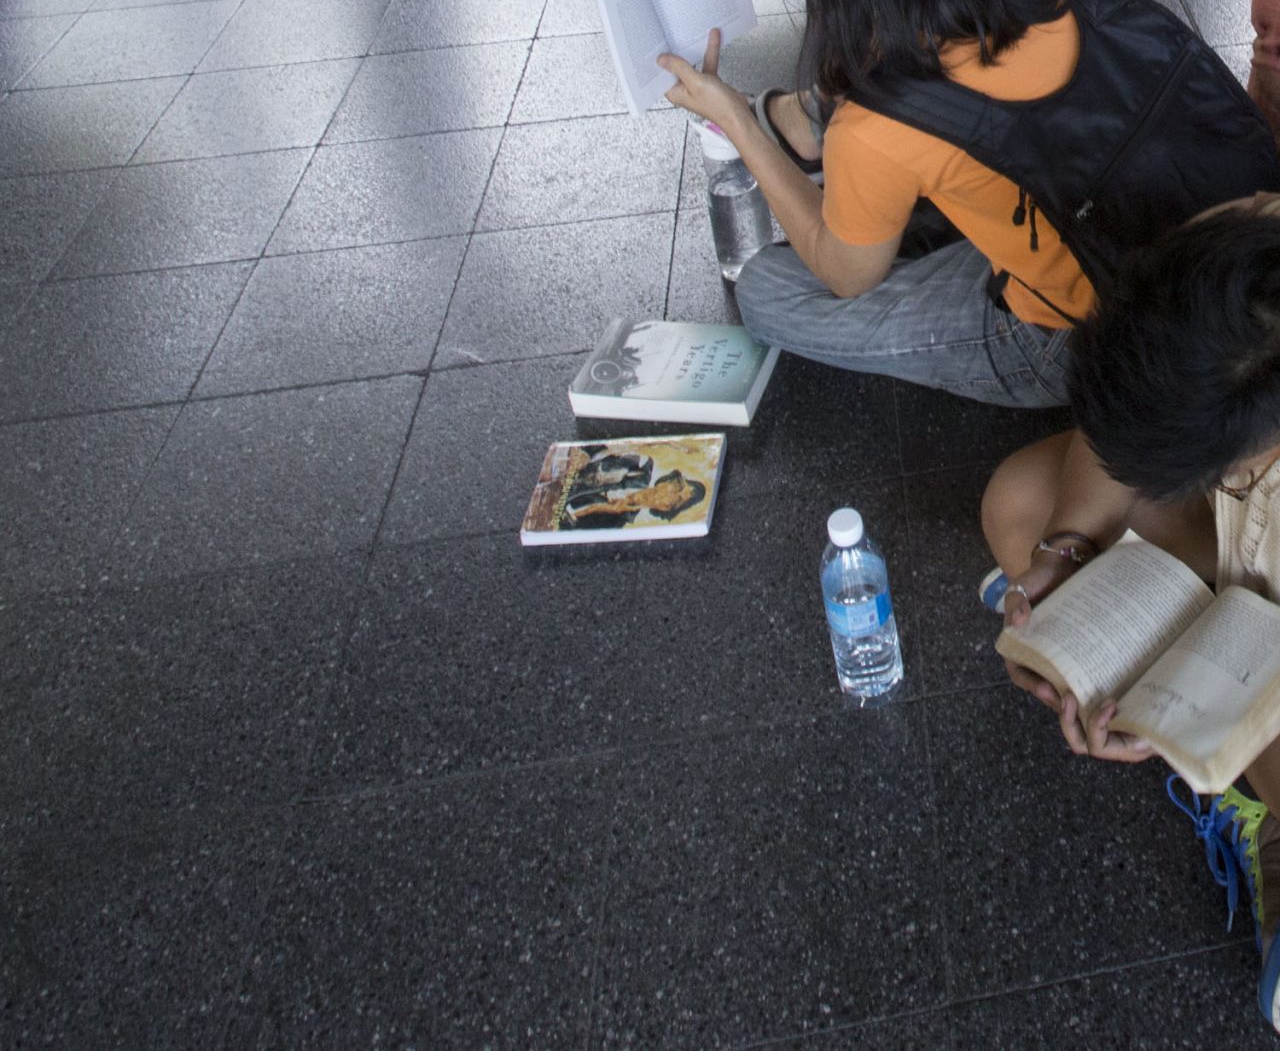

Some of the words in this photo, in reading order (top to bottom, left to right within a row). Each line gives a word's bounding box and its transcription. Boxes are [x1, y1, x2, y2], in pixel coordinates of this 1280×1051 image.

[676, 345, 705, 379] Years
[692, 339, 728, 388] Vertigo
[718, 351, 742, 378] The
